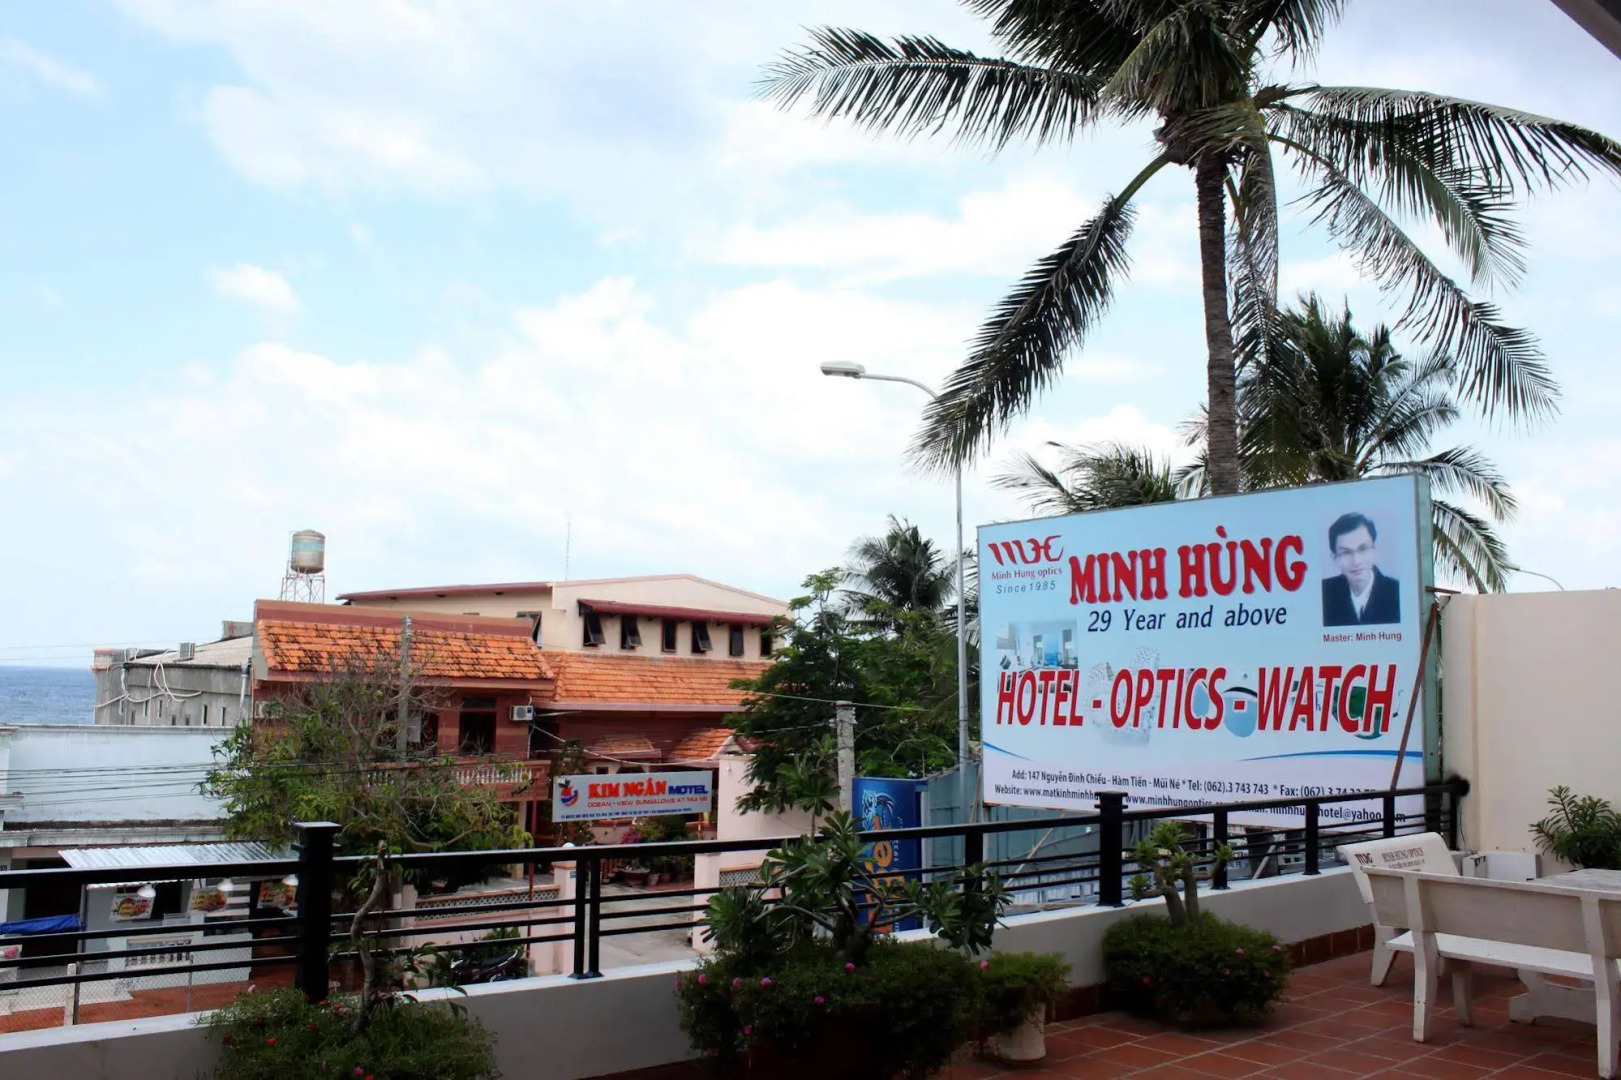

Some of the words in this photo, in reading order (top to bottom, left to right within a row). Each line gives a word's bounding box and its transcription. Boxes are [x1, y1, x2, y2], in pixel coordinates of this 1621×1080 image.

[991, 571, 1012, 581] Minh
[1013, 569, 1036, 580] Hung
[1037, 566, 1063, 578] optics
[1068, 547, 1168, 605] MINH
[1177, 525, 1308, 598] HÙNG
[996, 584, 1026, 595] Since
[1029, 580, 1056, 593] 1985
[1087, 610, 1112, 632] 29
[1123, 608, 1166, 631] Year
[1176, 604, 1214, 629] and
[1224, 603, 1287, 627] above
[1323, 633, 1353, 643] Master:
[1355, 632, 1376, 642] Minh
[1378, 631, 1402, 642] Hung
[996, 668, 1084, 727] HOTEL
[1110, 667, 1226, 731] OPTICS
[1257, 664, 1397, 733] WATCH
[587, 782, 620, 799] KIM
[622, 776, 667, 798] NGÂN
[668, 784, 709, 796] MOTEL
[994, 784, 1023, 797] Website:
[1012, 769, 1027, 781] Add:
[1028, 770, 1040, 782] 147
[1112, 774, 1130, 787] Hàm
[1187, 779, 1202, 792] Tel:
[1235, 782, 1251, 794] 743
[1253, 783, 1269, 795] 743
[1280, 784, 1299, 797] Fax:
[616, 799, 635, 807] VIEW
